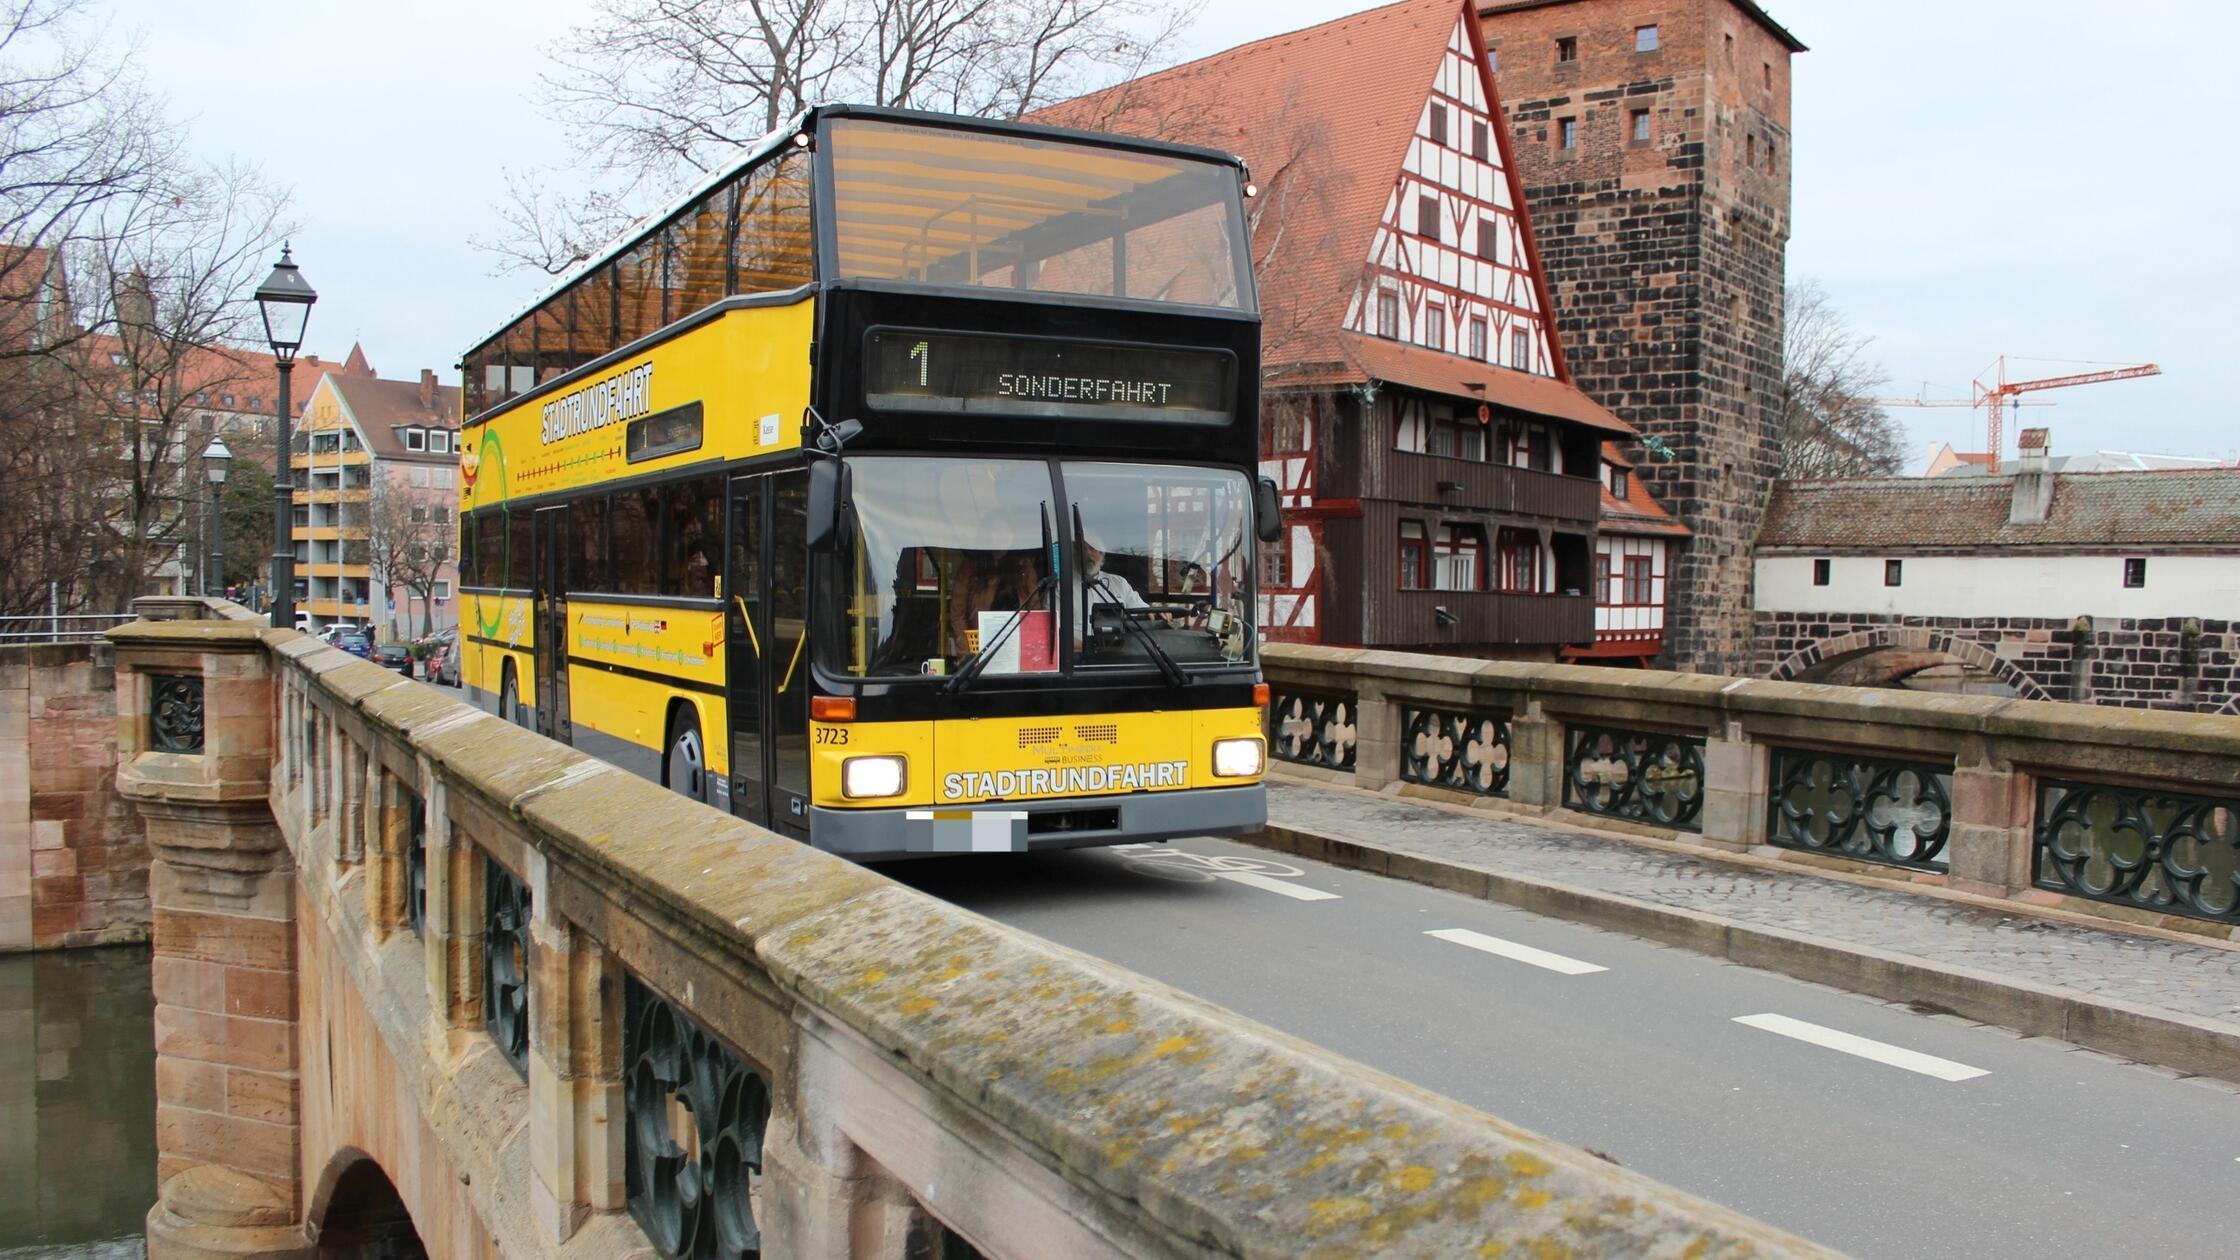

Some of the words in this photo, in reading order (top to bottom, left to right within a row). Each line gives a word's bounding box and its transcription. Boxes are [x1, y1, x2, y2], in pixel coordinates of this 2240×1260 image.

[910, 341, 928, 386] 1
[998, 374, 1172, 403] SONDERFAHRT
[541, 361, 653, 446] STADTRUNDFAHRT
[815, 727, 849, 745] 3723
[1062, 754, 1104, 764] BUSINESS
[943, 760, 1189, 800] STADTRUNDFAHRT
